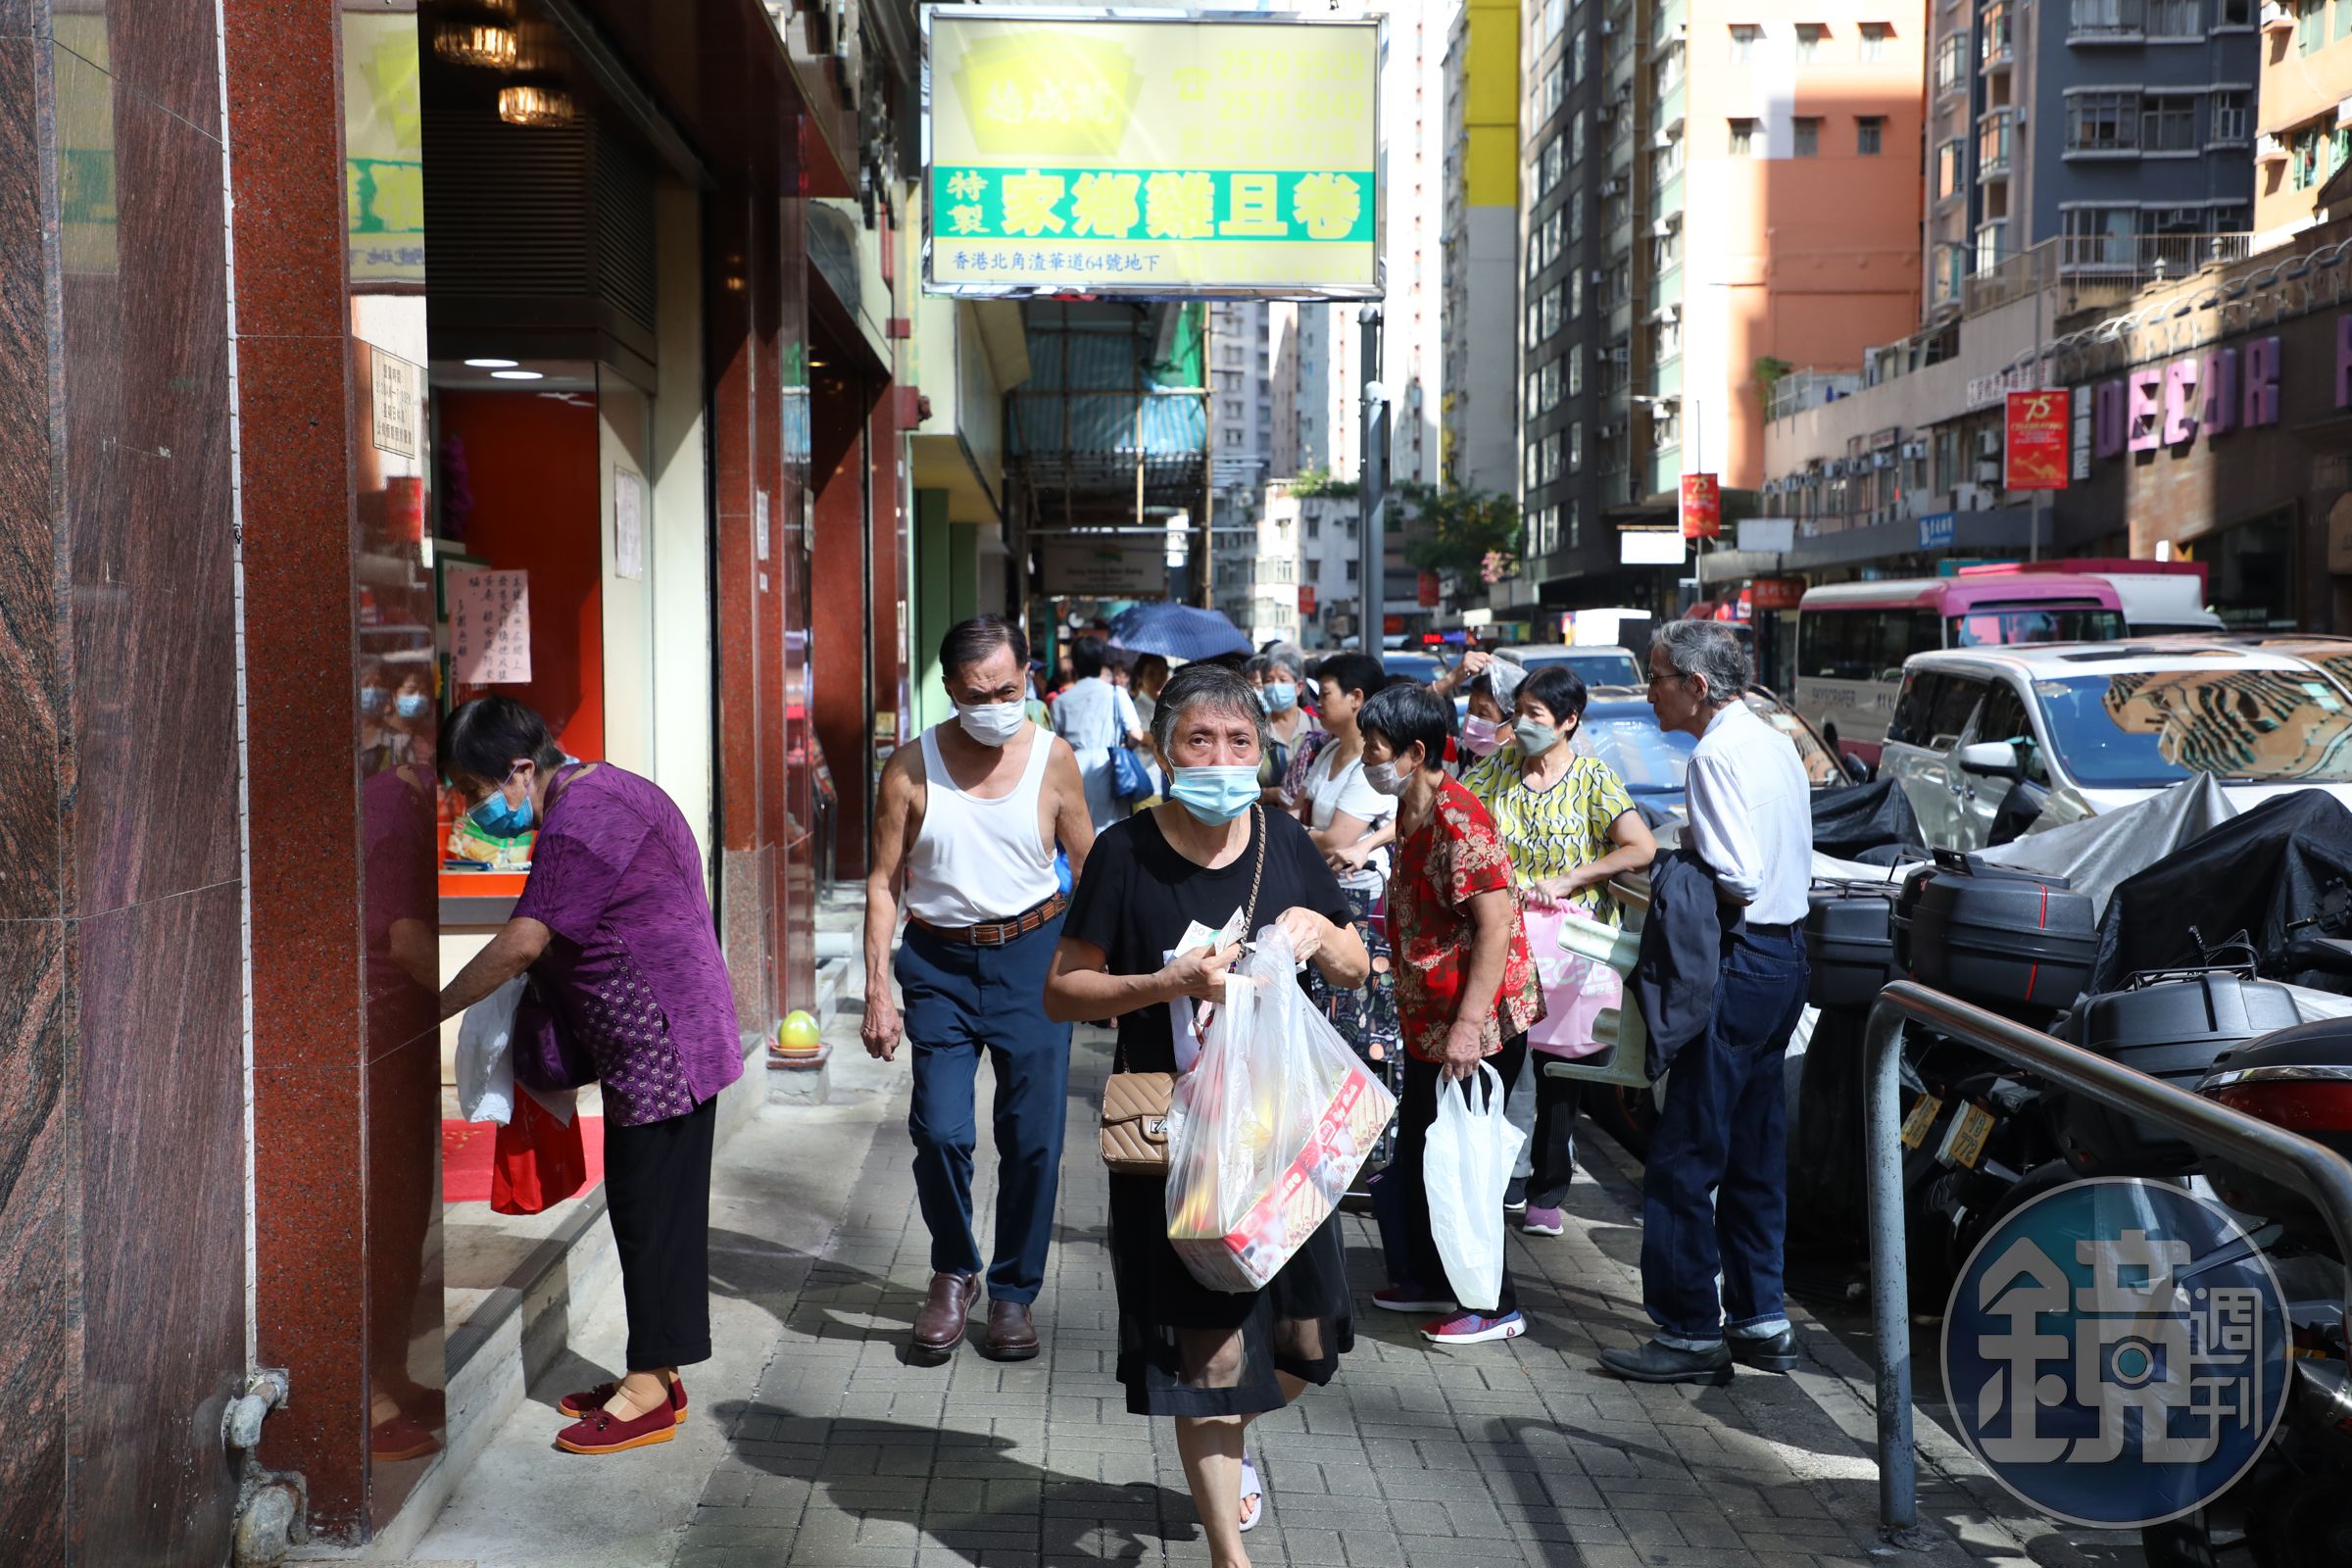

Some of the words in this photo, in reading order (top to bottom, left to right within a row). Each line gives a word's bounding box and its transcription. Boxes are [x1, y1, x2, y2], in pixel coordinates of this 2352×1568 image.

[946, 170, 991, 235] 特製
[952, 250, 1161, 273] 香港北角渣華道64號地下
[2022, 394, 2054, 421] 75
